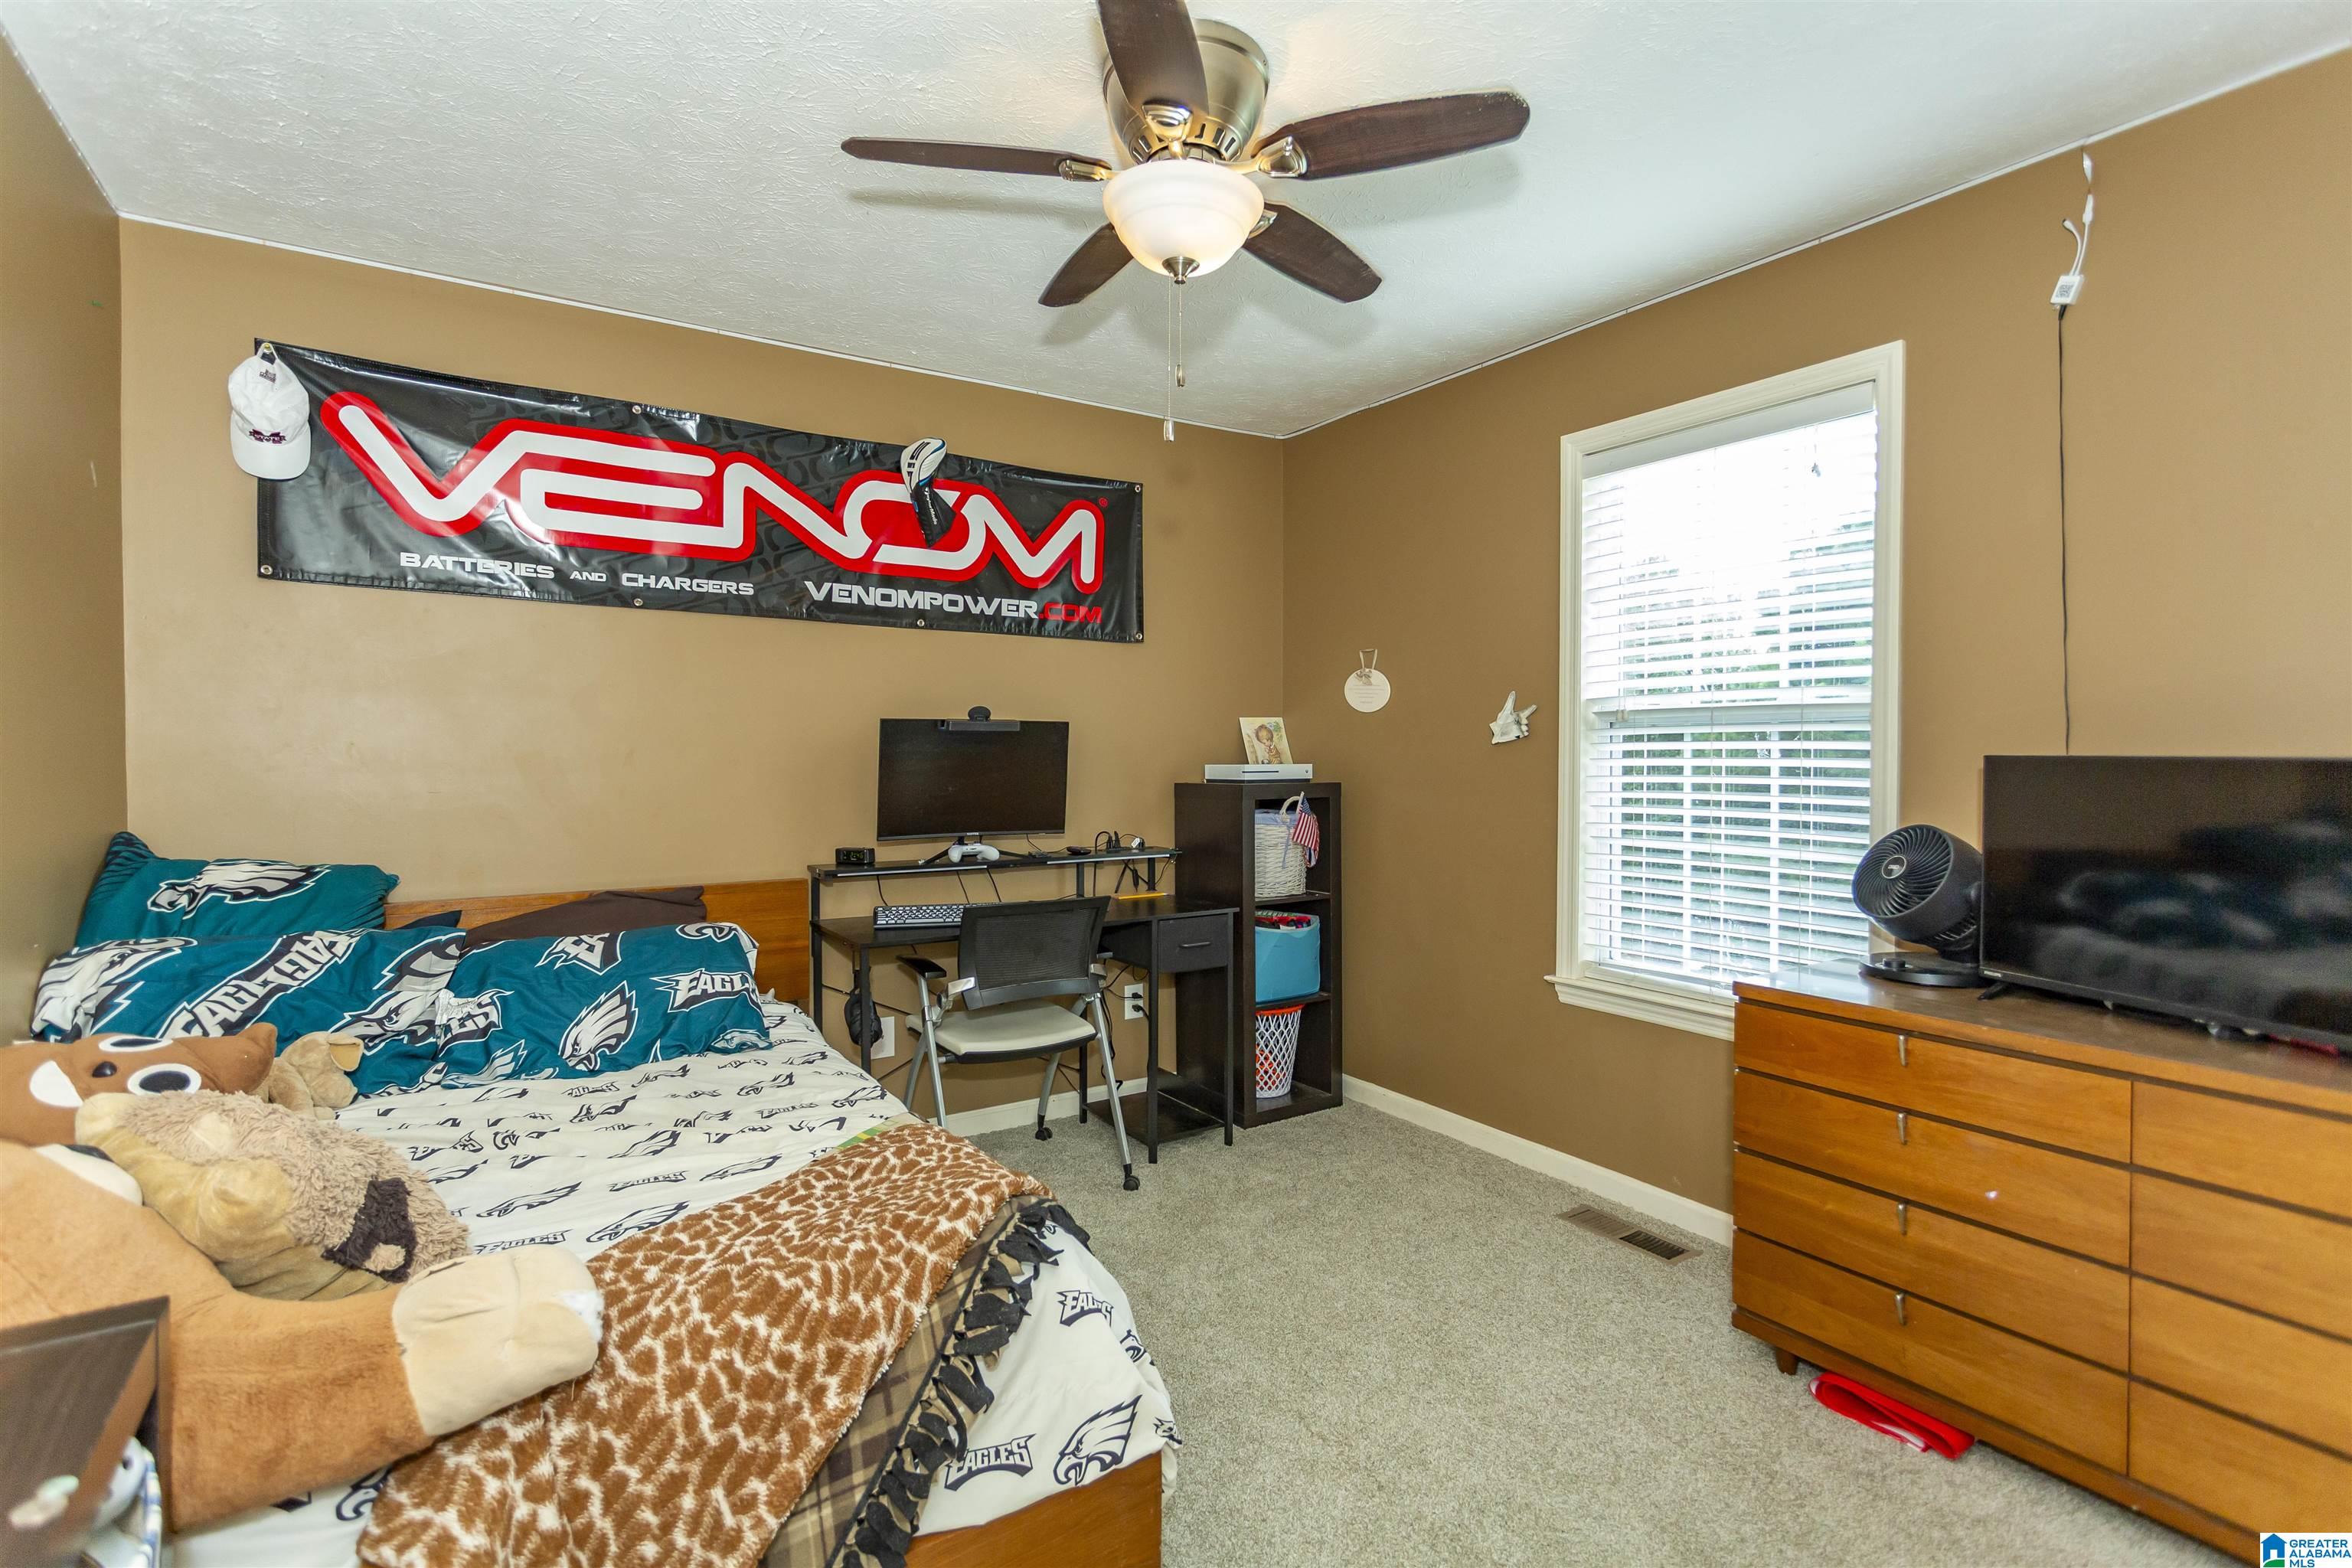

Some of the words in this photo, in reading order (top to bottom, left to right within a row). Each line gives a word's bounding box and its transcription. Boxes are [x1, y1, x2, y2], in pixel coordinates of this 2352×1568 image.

[320, 391, 1105, 595] VENOM
[400, 551, 554, 579] BATTERIES
[569, 570, 607, 582] AND
[621, 573, 754, 596] CHARGERS
[804, 580, 1102, 624] VENOMPOWER.COM
[669, 970, 754, 1008] EAGL
